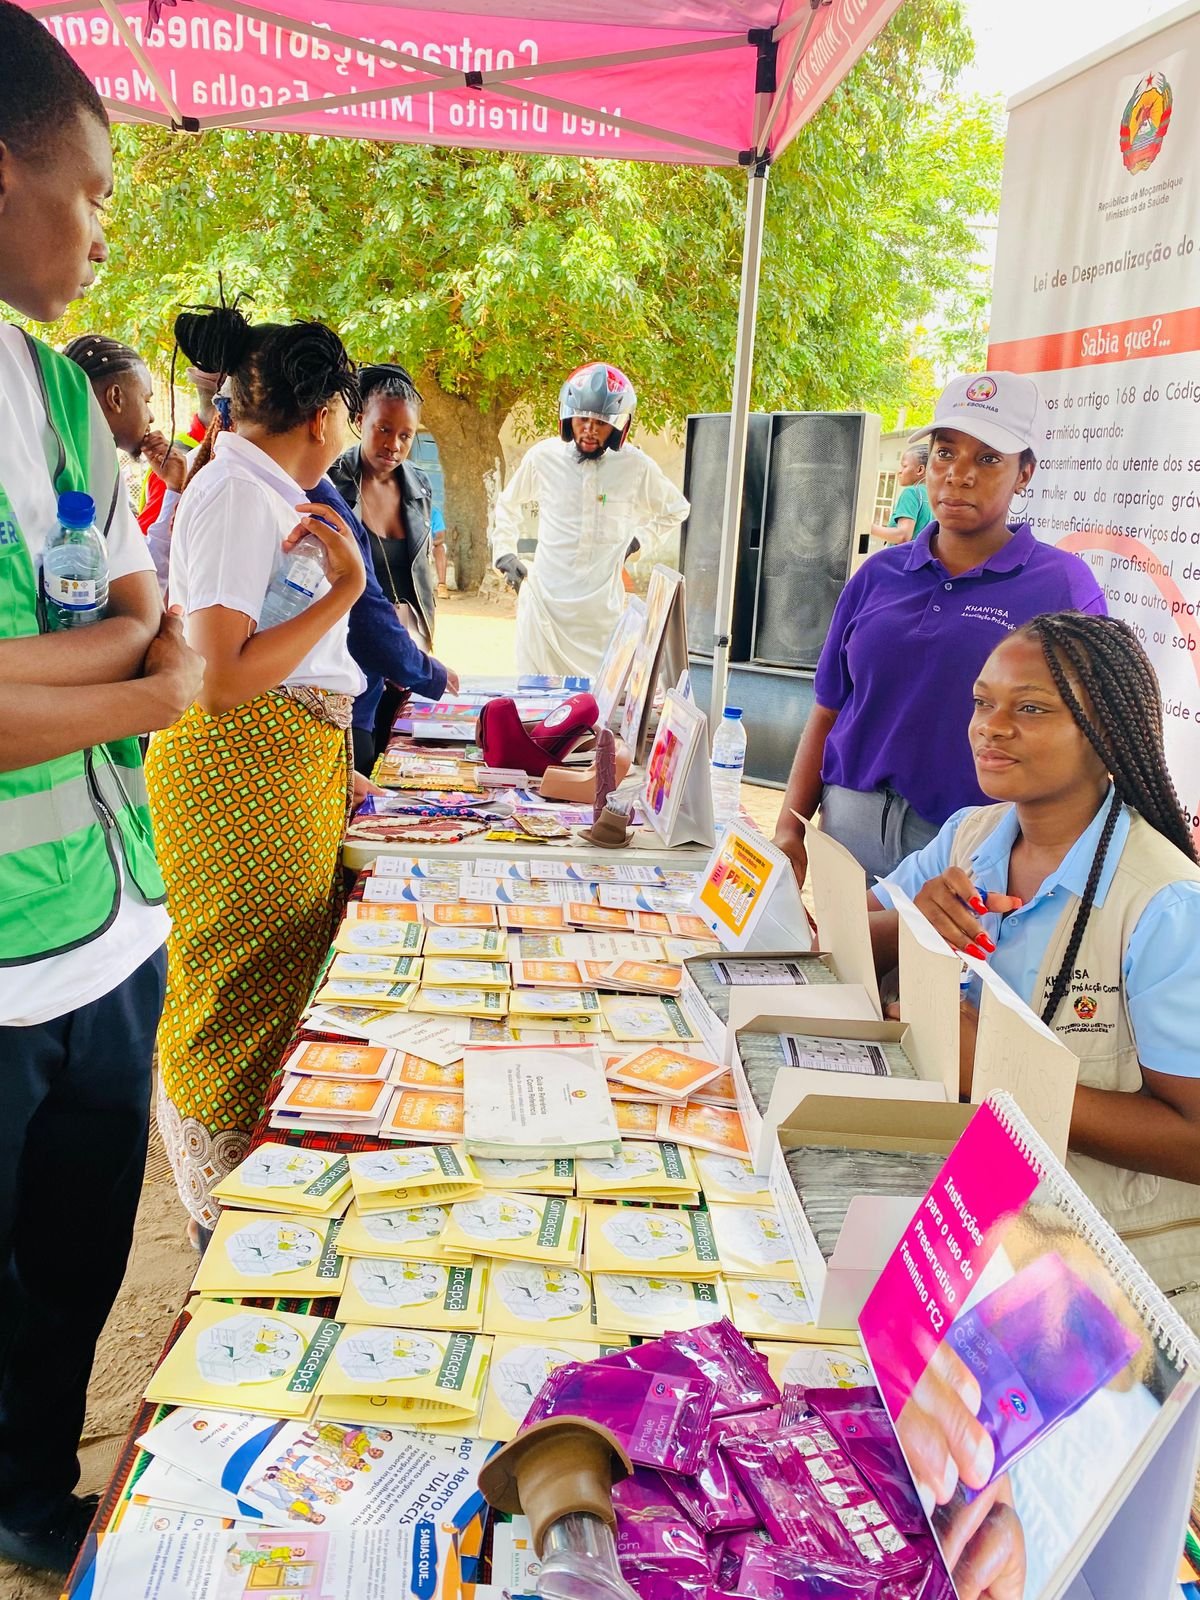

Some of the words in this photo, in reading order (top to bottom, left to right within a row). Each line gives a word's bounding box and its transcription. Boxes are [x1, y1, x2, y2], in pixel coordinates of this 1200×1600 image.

[1098, 192, 1129, 212] República
[1130, 191, 1138, 203] de
[1140, 177, 1183, 198] Moçambique
[1106, 203, 1137, 222] Ministério
[1147, 194, 1169, 209] Saúde
[1034, 273, 1048, 293] Lei
[1051, 269, 1067, 288] de
[1072, 243, 1171, 284] Despenalização
[1177, 234, 1193, 257] do
[1081, 329, 1119, 358] Sabia
[1064, 395, 1073, 409] do
[1077, 393, 1109, 411] artigo
[1116, 387, 1136, 405] 168
[1143, 384, 1159, 402] do
[1045, 425, 1080, 441] ermitido
[1083, 423, 1124, 446] quando:
[1105, 454, 1119, 472] da
[1122, 454, 1158, 473] utente
[1163, 454, 1182, 472] dos
[1073, 490, 1086, 502] ou
[1093, 486, 1106, 503] da
[1113, 488, 1164, 512] rapariga
[1037, 516, 1050, 528] ser
[1051, 514, 1104, 535] beneficiária
[1105, 520, 1123, 538] dos
[1125, 522, 1169, 546] serviços
[1170, 526, 1187, 545] do
[1091, 554, 1104, 567] um
[1110, 554, 1173, 577] profissional
[964, 605, 1009, 619] KHANYISA
[1124, 591, 1138, 604] ou
[1141, 593, 1168, 611] outro
[1153, 631, 1166, 645] ou
[1172, 632, 1197, 651] sob
[944, 1176, 984, 1246] Instruções
[925, 1195, 943, 1226] para
[940, 1224, 949, 1236] o
[946, 1233, 962, 1261] uso
[960, 1259, 974, 1281] do
[914, 1220, 956, 1303] Preservativo
[900, 1240, 929, 1303] Feminino
[925, 1299, 945, 1333] FC2
[963, 1317, 993, 1356] Female
[954, 1326, 989, 1375] Condom
[634, 1418, 656, 1452] Female
[388, 1451, 405, 1471] aborto
[397, 1448, 421, 1474] raparigas
[414, 1460, 431, 1479] aborto
[369, 1477, 394, 1504] mulheres
[425, 1471, 450, 1492] TUA
[431, 1467, 470, 1511] ABORTO
[373, 1499, 385, 1516] para
[386, 1503, 395, 1513] um
[400, 1493, 431, 1525] DECIS
[420, 1528, 431, 1559] SABIAS
[418, 1560, 430, 1587] QUE...
